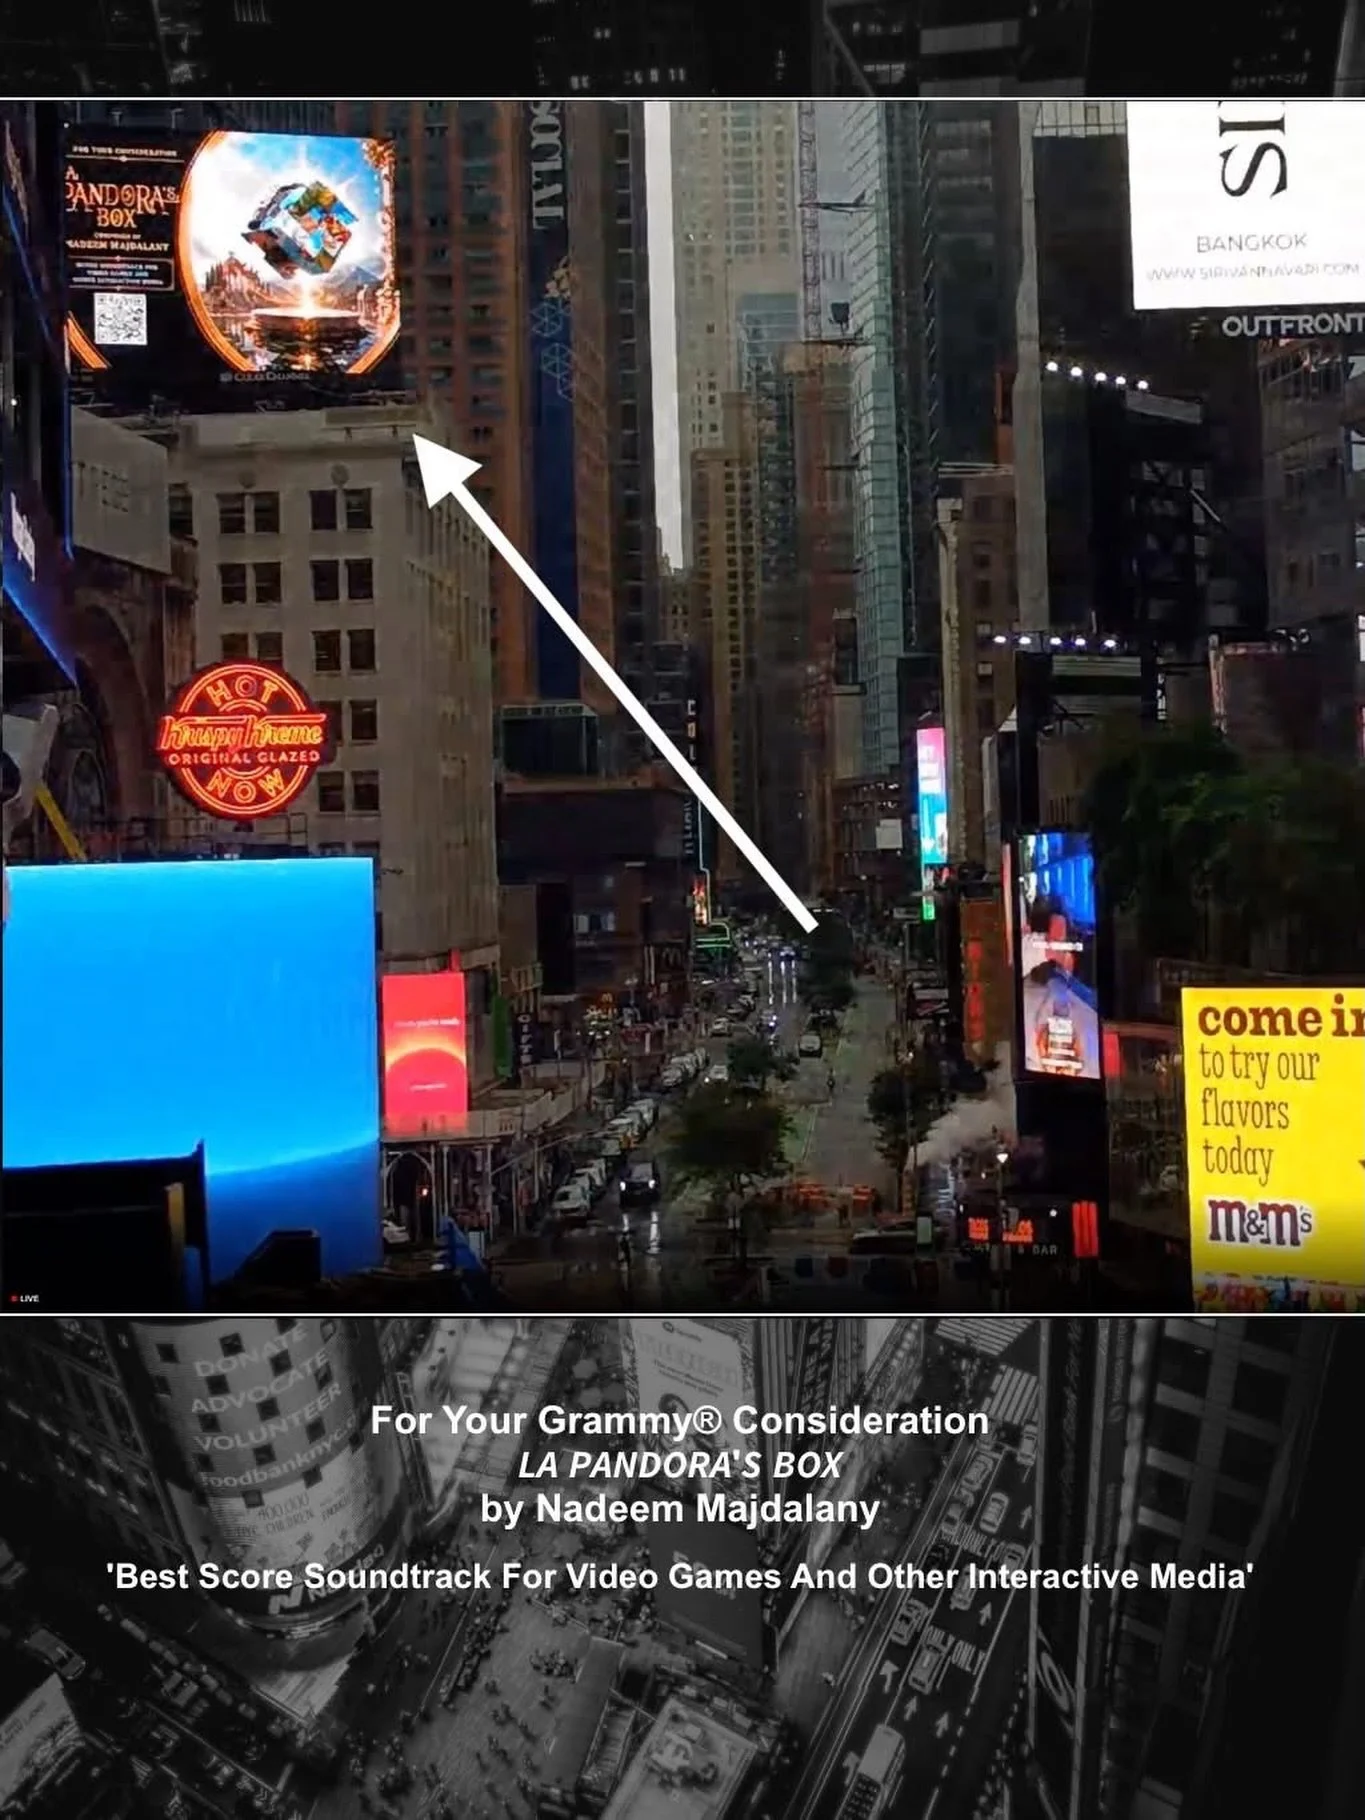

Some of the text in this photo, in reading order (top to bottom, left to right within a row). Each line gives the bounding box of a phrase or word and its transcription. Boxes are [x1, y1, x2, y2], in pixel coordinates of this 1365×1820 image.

[1217, 101, 1288, 199] SI
[96, 207, 137, 229] BOX
[1197, 232, 1308, 254] BANGKOK
[206, 675, 279, 707] HOT
[169, 750, 320, 765] ORIGINAL GLAZED
[206, 767, 285, 803] NOW
[1198, 1006, 1323, 1037] come
[1200, 1043, 1320, 1090] to try our
[1201, 1087, 1290, 1129] flavors
[1203, 1135, 1274, 1187] today
[194, 1323, 307, 1377] DONATE
[192, 1348, 329, 1413] ADVOCATE
[194, 1382, 341, 1451] VOLUNTEER
